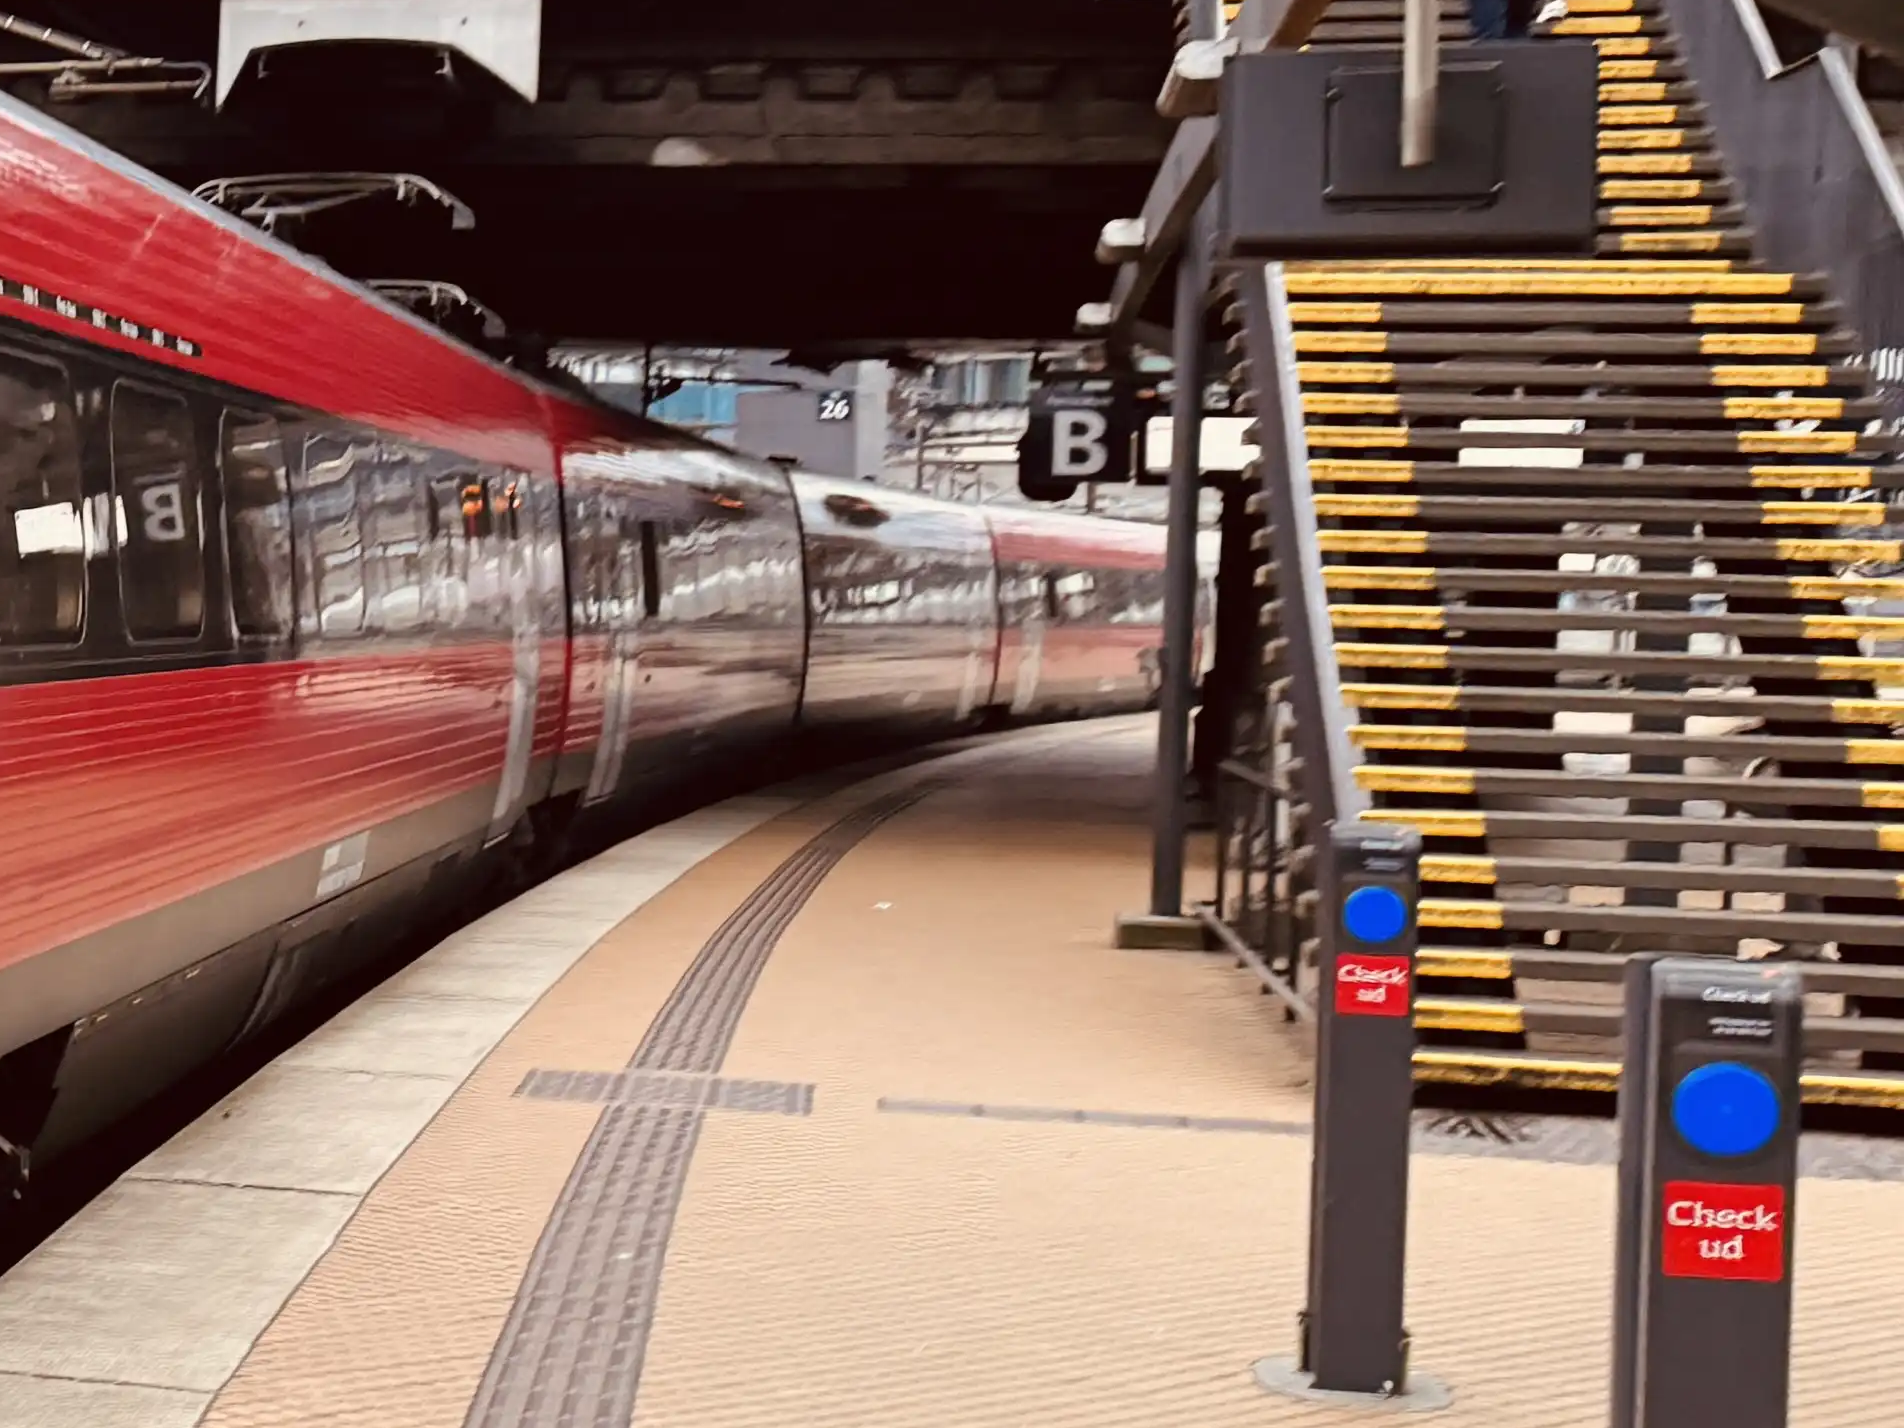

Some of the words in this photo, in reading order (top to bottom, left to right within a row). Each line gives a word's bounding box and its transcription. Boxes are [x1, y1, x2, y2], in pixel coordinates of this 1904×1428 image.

[820, 399, 850, 420] 26
[1051, 409, 1109, 477] B
[1666, 1200, 1779, 1231] Check
[1698, 1234, 1746, 1260] ud
